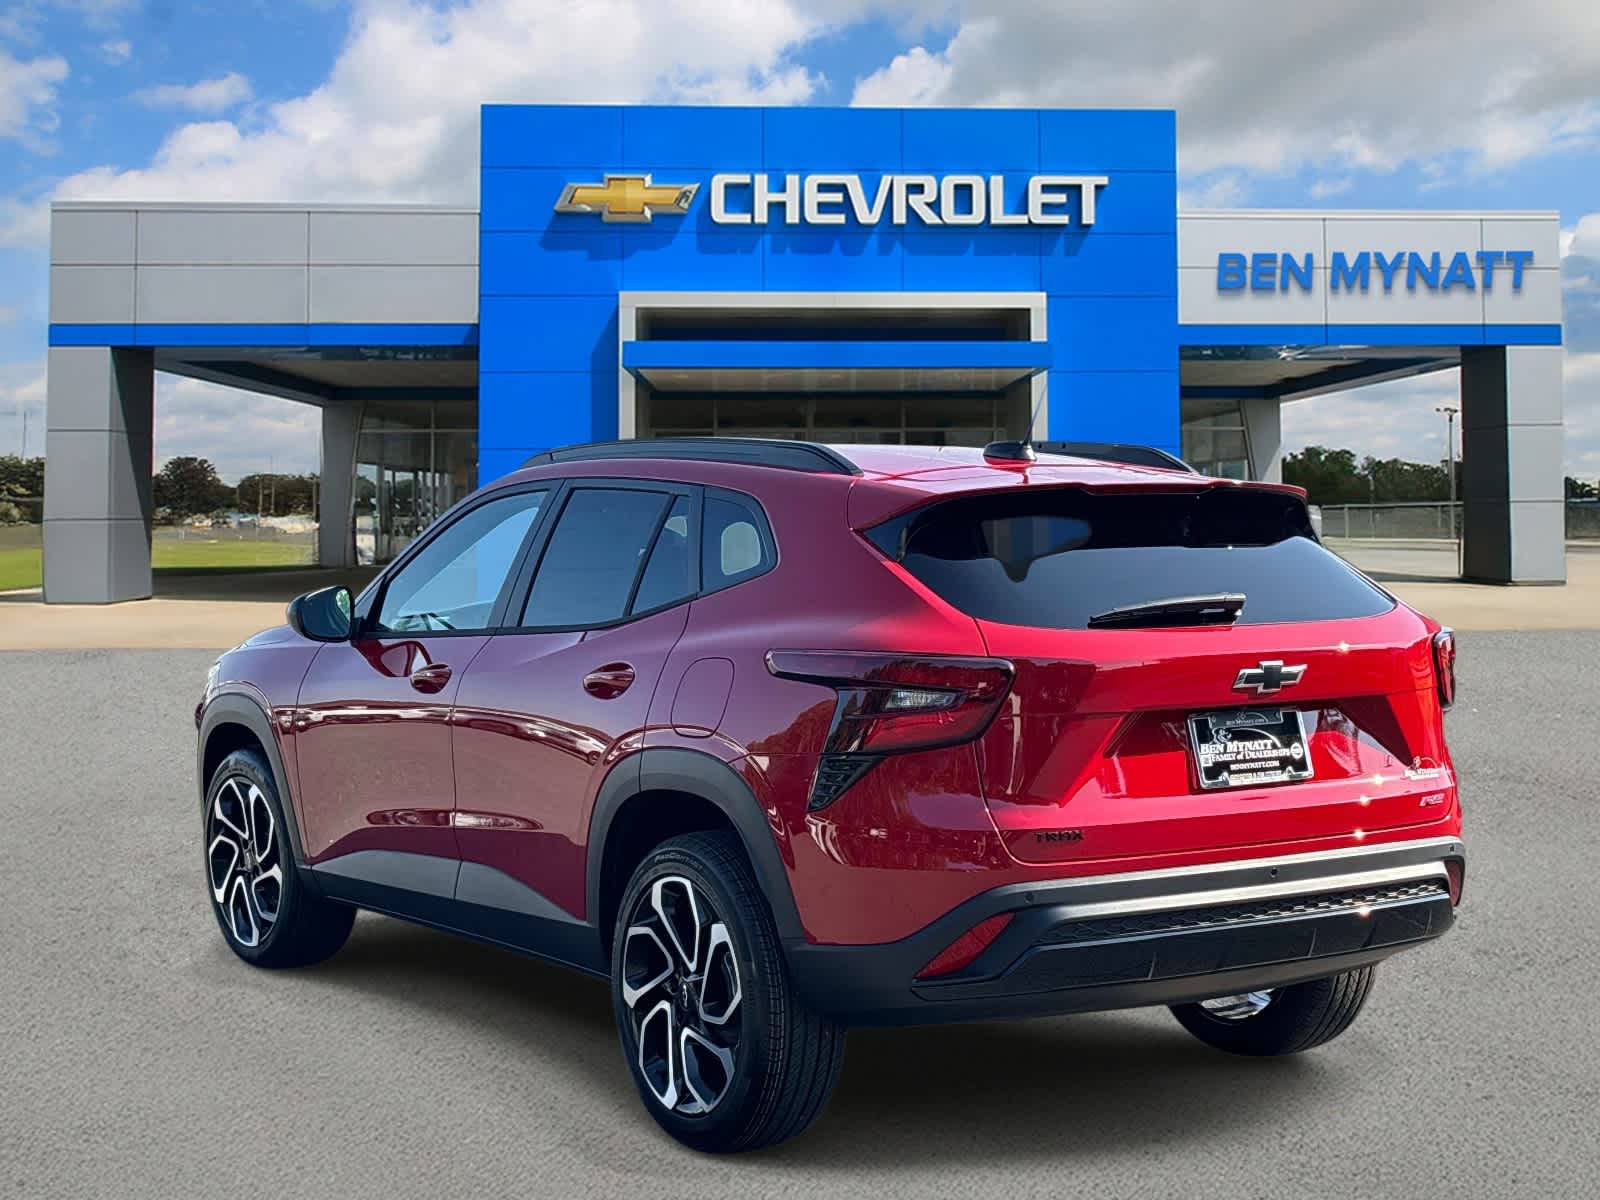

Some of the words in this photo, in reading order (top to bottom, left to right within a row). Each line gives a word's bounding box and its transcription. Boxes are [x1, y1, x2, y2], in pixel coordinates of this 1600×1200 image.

[711, 174, 1109, 225] CHEVROLET
[1217, 252, 1313, 290] BEN
[1330, 251, 1534, 290] MYNATT
[1200, 743, 1224, 754] BEN
[1227, 739, 1273, 752] MYNATT
[1211, 752, 1237, 762] FAMILY
[1034, 831, 1083, 843] TRAX
